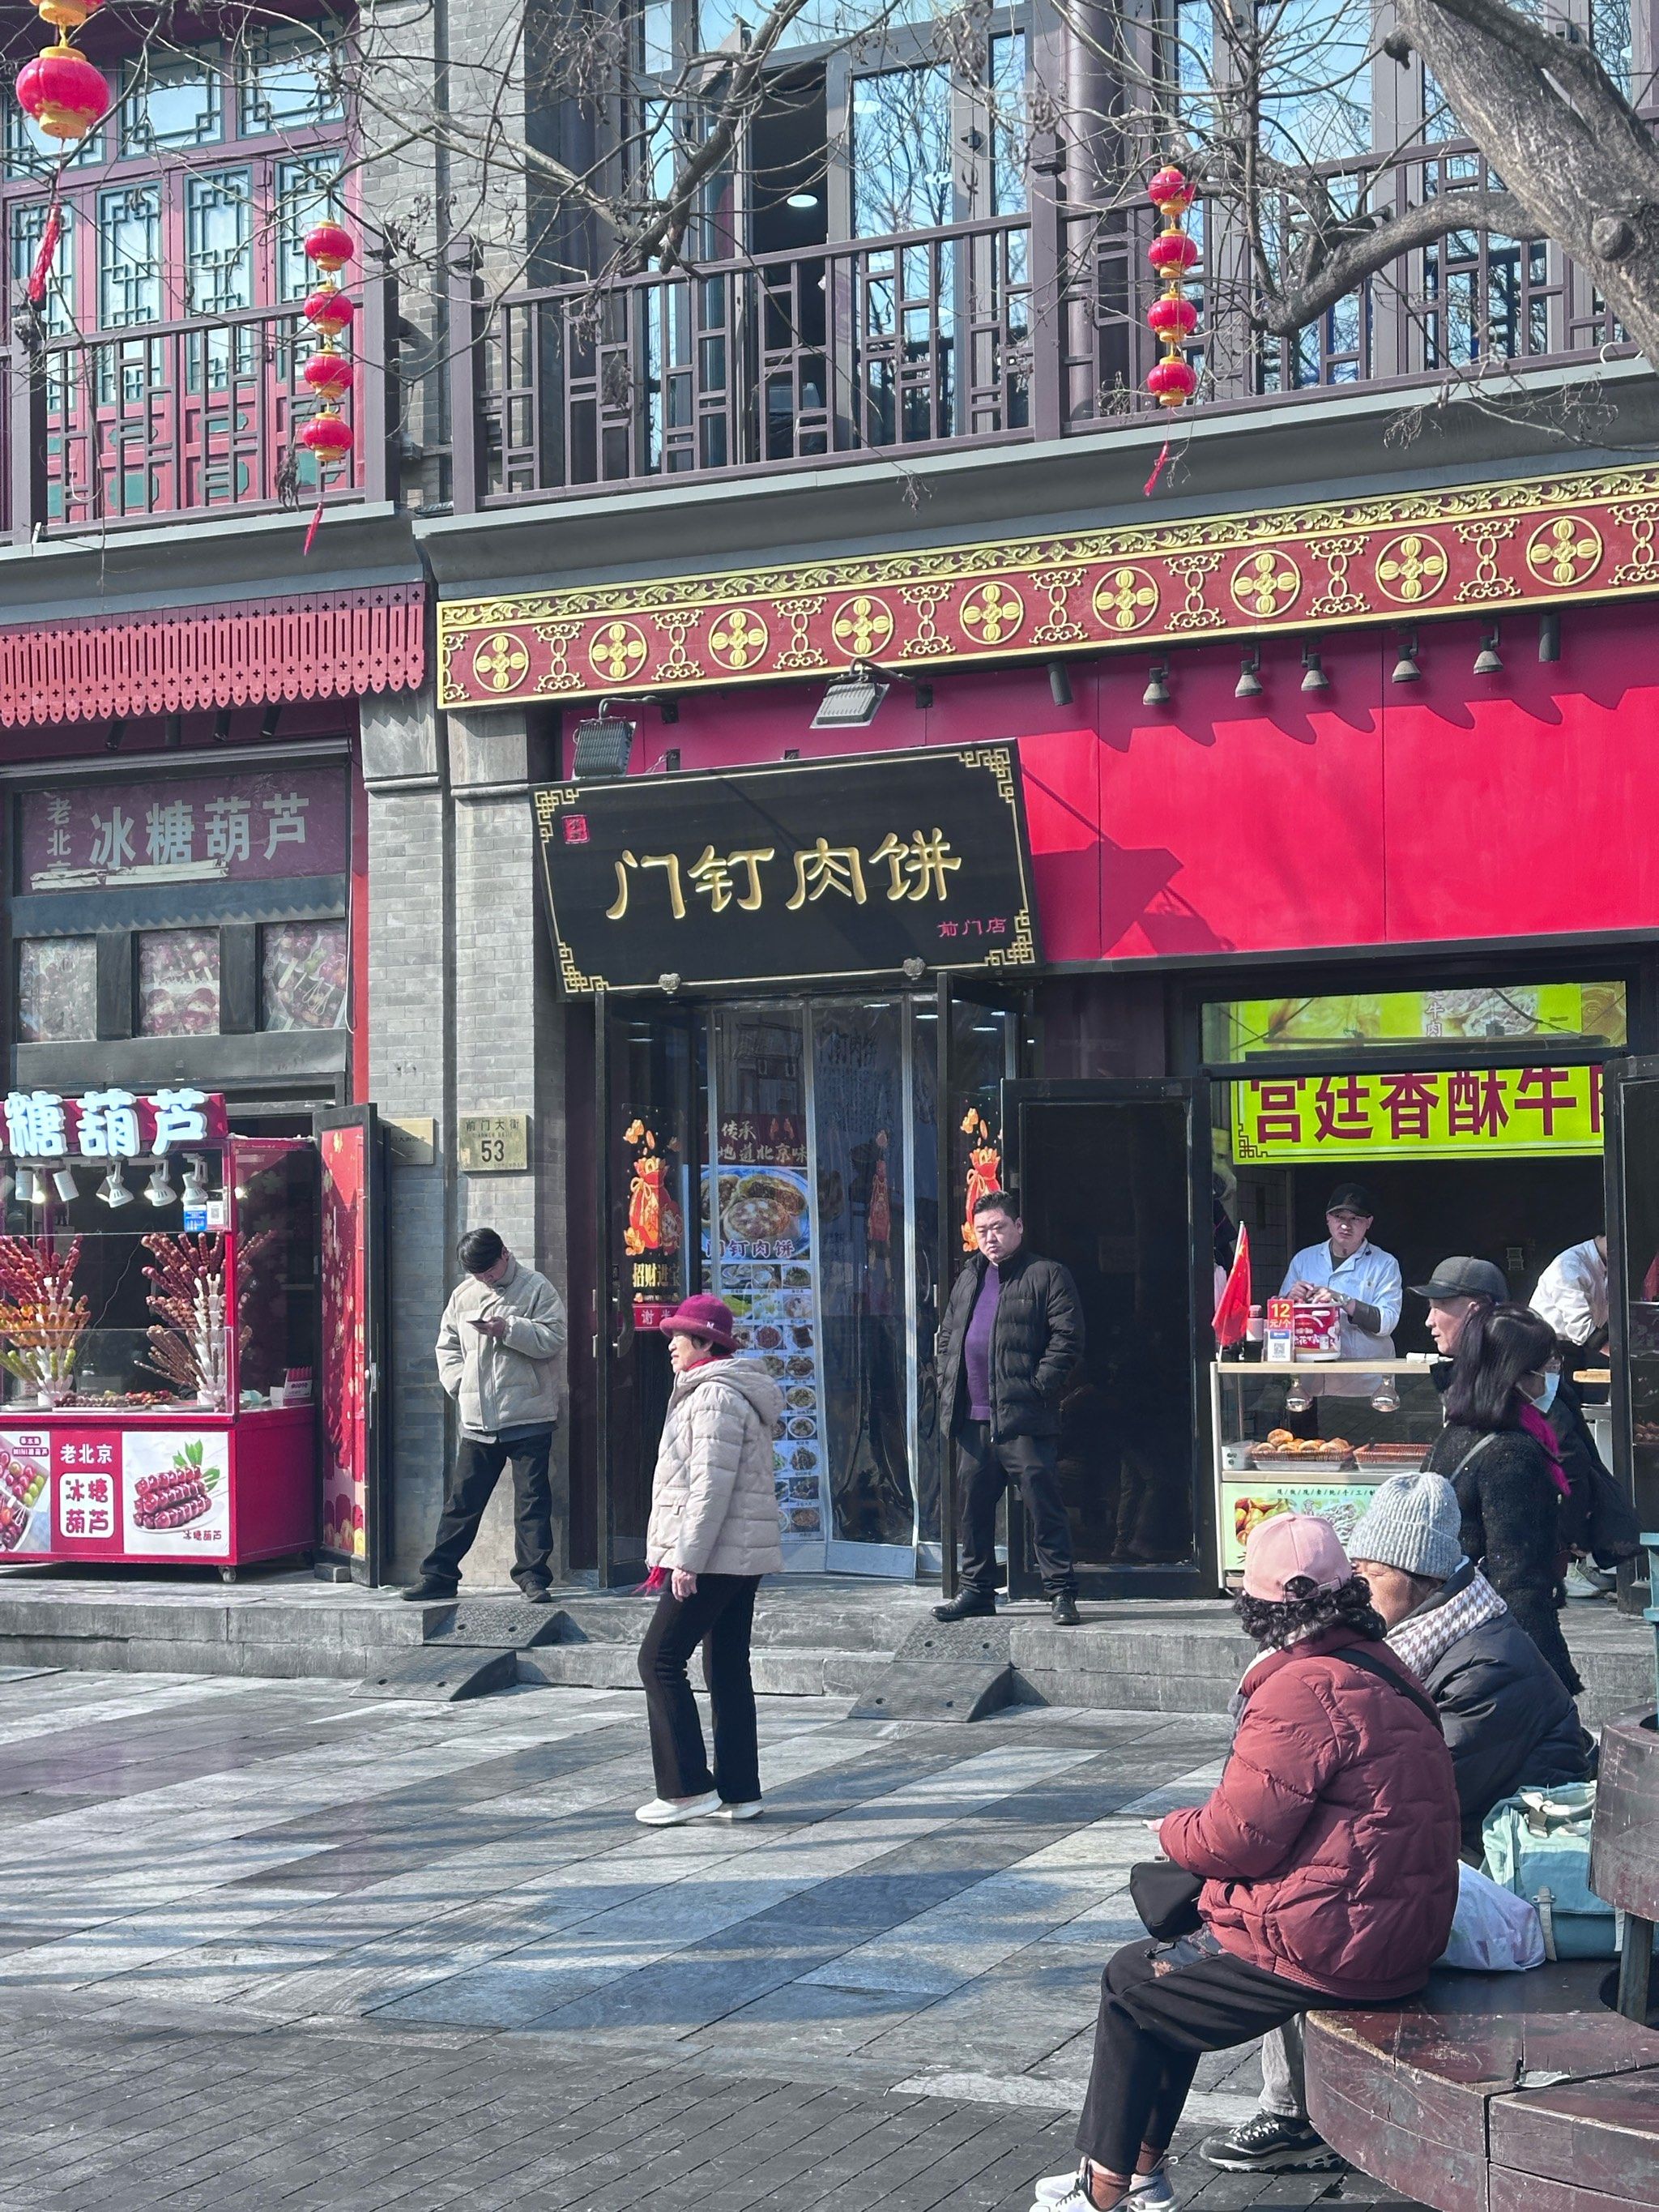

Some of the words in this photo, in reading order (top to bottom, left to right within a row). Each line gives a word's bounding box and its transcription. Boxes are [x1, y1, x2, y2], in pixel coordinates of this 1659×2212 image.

[88, 792, 309, 870] 冰糖葫芦
[606, 827, 962, 920] 门钉肉饼
[936, 917, 1007, 937] 前门店
[1250, 1065, 1605, 1144] 宫廷香酥牛
[0, 1088, 209, 1157] 糖葫芦
[466, 1119, 519, 1131] 前门大街
[481, 1139, 505, 1163] 53
[718, 1142, 808, 1164] 地道北京味
[633, 1262, 681, 1287] 招财进宝
[1271, 1303, 1291, 1318] 12
[1269, 1318, 1292, 1328] 元/个
[60, 1443, 113, 1464] 老北京
[65, 1478, 109, 1503] 冰糖
[65, 1509, 109, 1534] 葫芦
